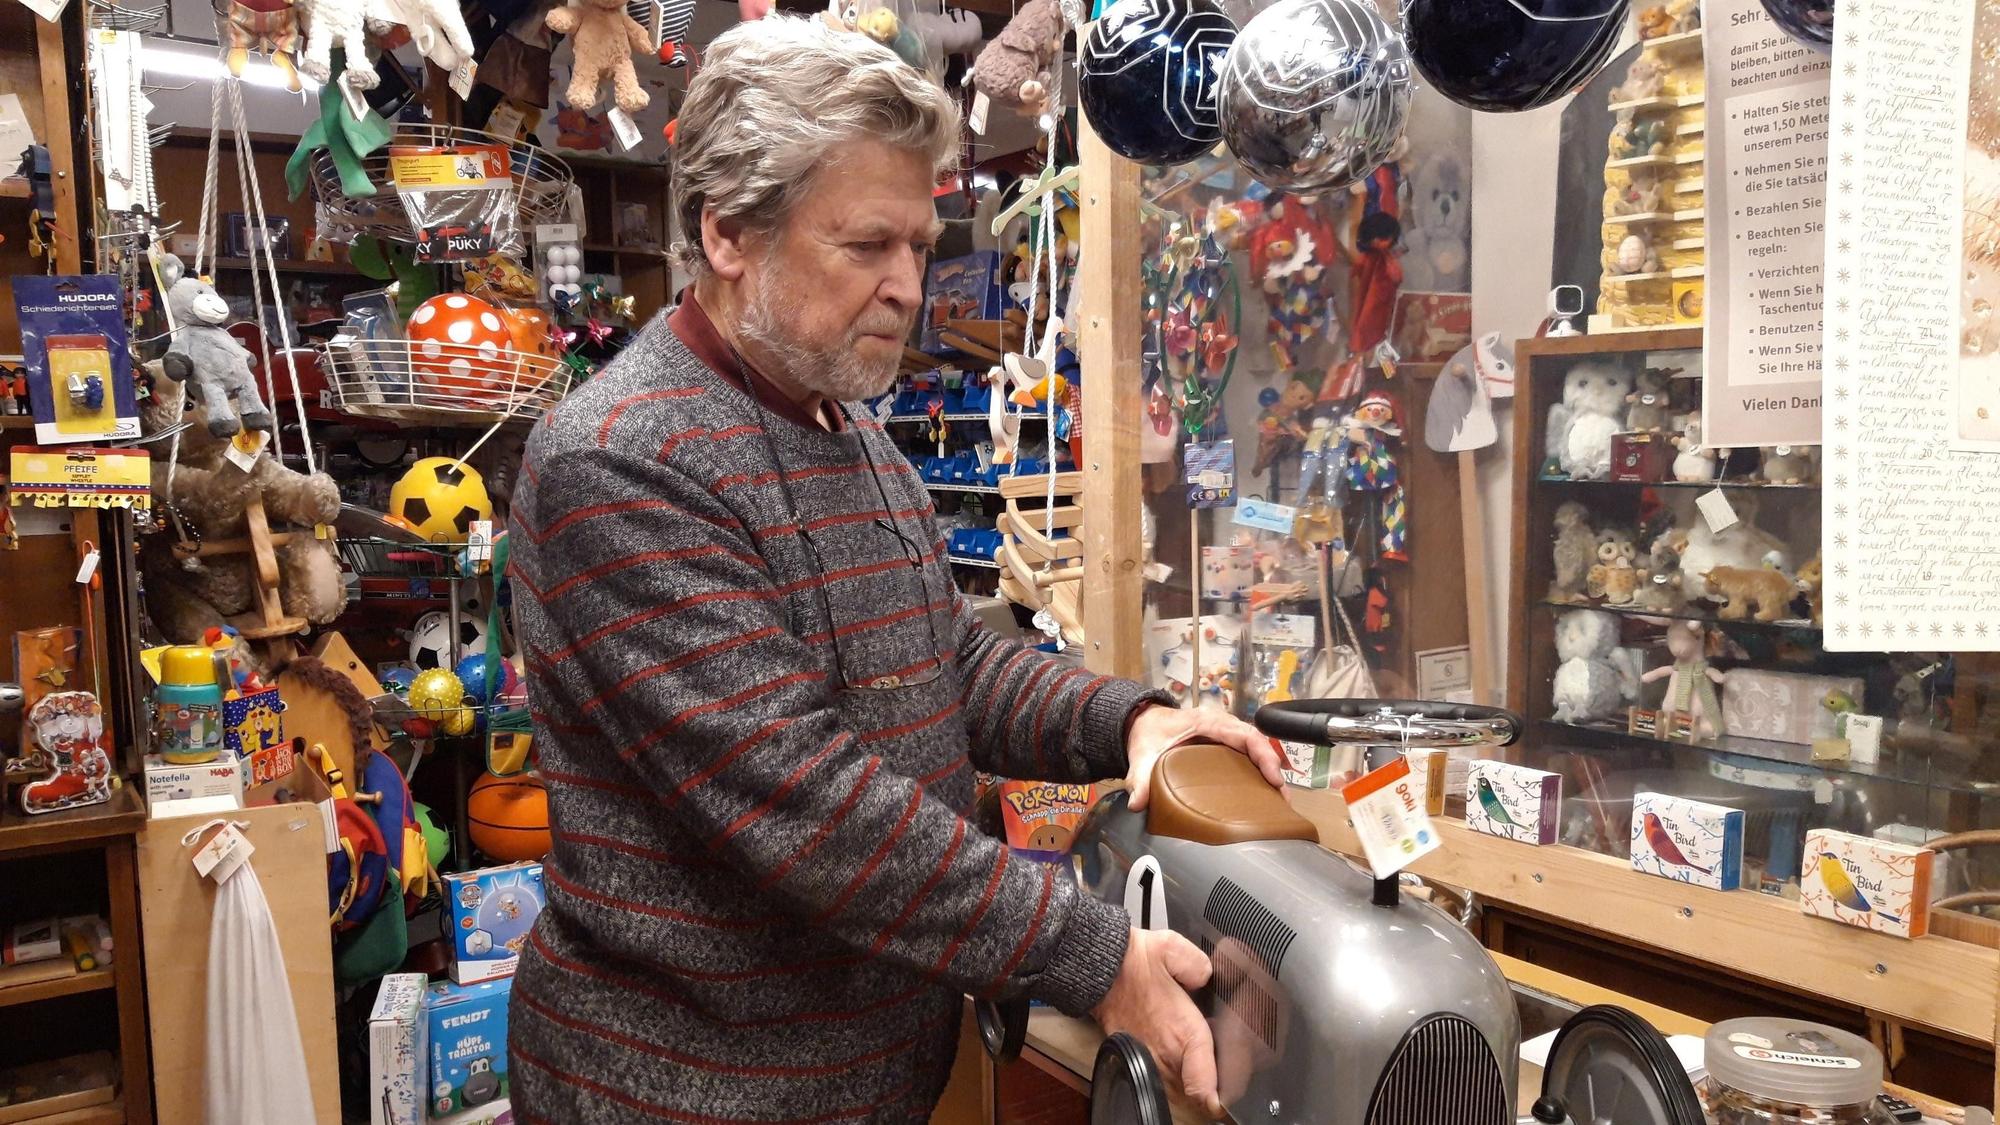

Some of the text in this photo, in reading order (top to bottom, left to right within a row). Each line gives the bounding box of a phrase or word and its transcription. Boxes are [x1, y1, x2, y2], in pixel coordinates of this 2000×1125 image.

[1730, 9, 1761, 27] Sehr
[1730, 41, 1759, 56] damit
[1761, 37, 1777, 50] Sie
[1730, 56, 1771, 71] bleiben,
[1773, 48, 1804, 62] bitten
[1731, 70, 1777, 88] beachten
[1780, 64, 1799, 78] und
[1931, 84, 1942, 96] 23
[1743, 106, 1779, 120] Halten
[1782, 100, 1800, 113] Sie
[1743, 124, 1770, 136] etwa
[1773, 117, 1796, 132] 1,50
[1744, 137, 1792, 152] unserem
[1745, 161, 1791, 176] Nehmen
[1795, 156, 1814, 169] Sie
[1745, 181, 1762, 193] die
[1765, 178, 1783, 190] Sie
[1746, 197, 1822, 217] Bezahlen Sie
[1926, 205, 1937, 216] 22
[1747, 221, 1824, 241] Beachten Sie
[1748, 243, 1787, 258] regeln:
[1757, 264, 1819, 279] Verzichten
[58, 293, 116, 303] HUDORA
[1758, 288, 1790, 300] Wenn
[1793, 284, 1813, 297] Sie
[20, 303, 118, 313] Schiedsrichterset
[1759, 322, 1814, 336] Benutzen
[1758, 345, 1791, 356] Wenn
[1794, 342, 1814, 354] Sie
[1758, 363, 1778, 374] Sie
[1780, 361, 1804, 373] Ihre
[1742, 397, 1787, 411] Vielen
[1922, 447, 1933, 459] 20
[64, 465, 98, 474] PFEIFE
[149, 773, 191, 784] Notefella
[209, 767, 235, 778] HABA
[1492, 780, 1505, 794] Tin
[1395, 782, 1418, 813] goki
[1501, 794, 1519, 808] Bird
[1021, 810, 1048, 824] Schnapp
[1060, 806, 1070, 814] Dir
[1662, 816, 1679, 831] Tin
[1674, 831, 1697, 848] Bird
[1842, 857, 1863, 874] Tin
[1856, 874, 1884, 893] Bird
[1136, 866, 1156, 931] 1
[441, 1008, 492, 1030] FENDT
[456, 1035, 482, 1050] HÜPF
[447, 1041, 491, 1061] TRAKTOR
[1775, 1053, 1847, 1066] Schleich
